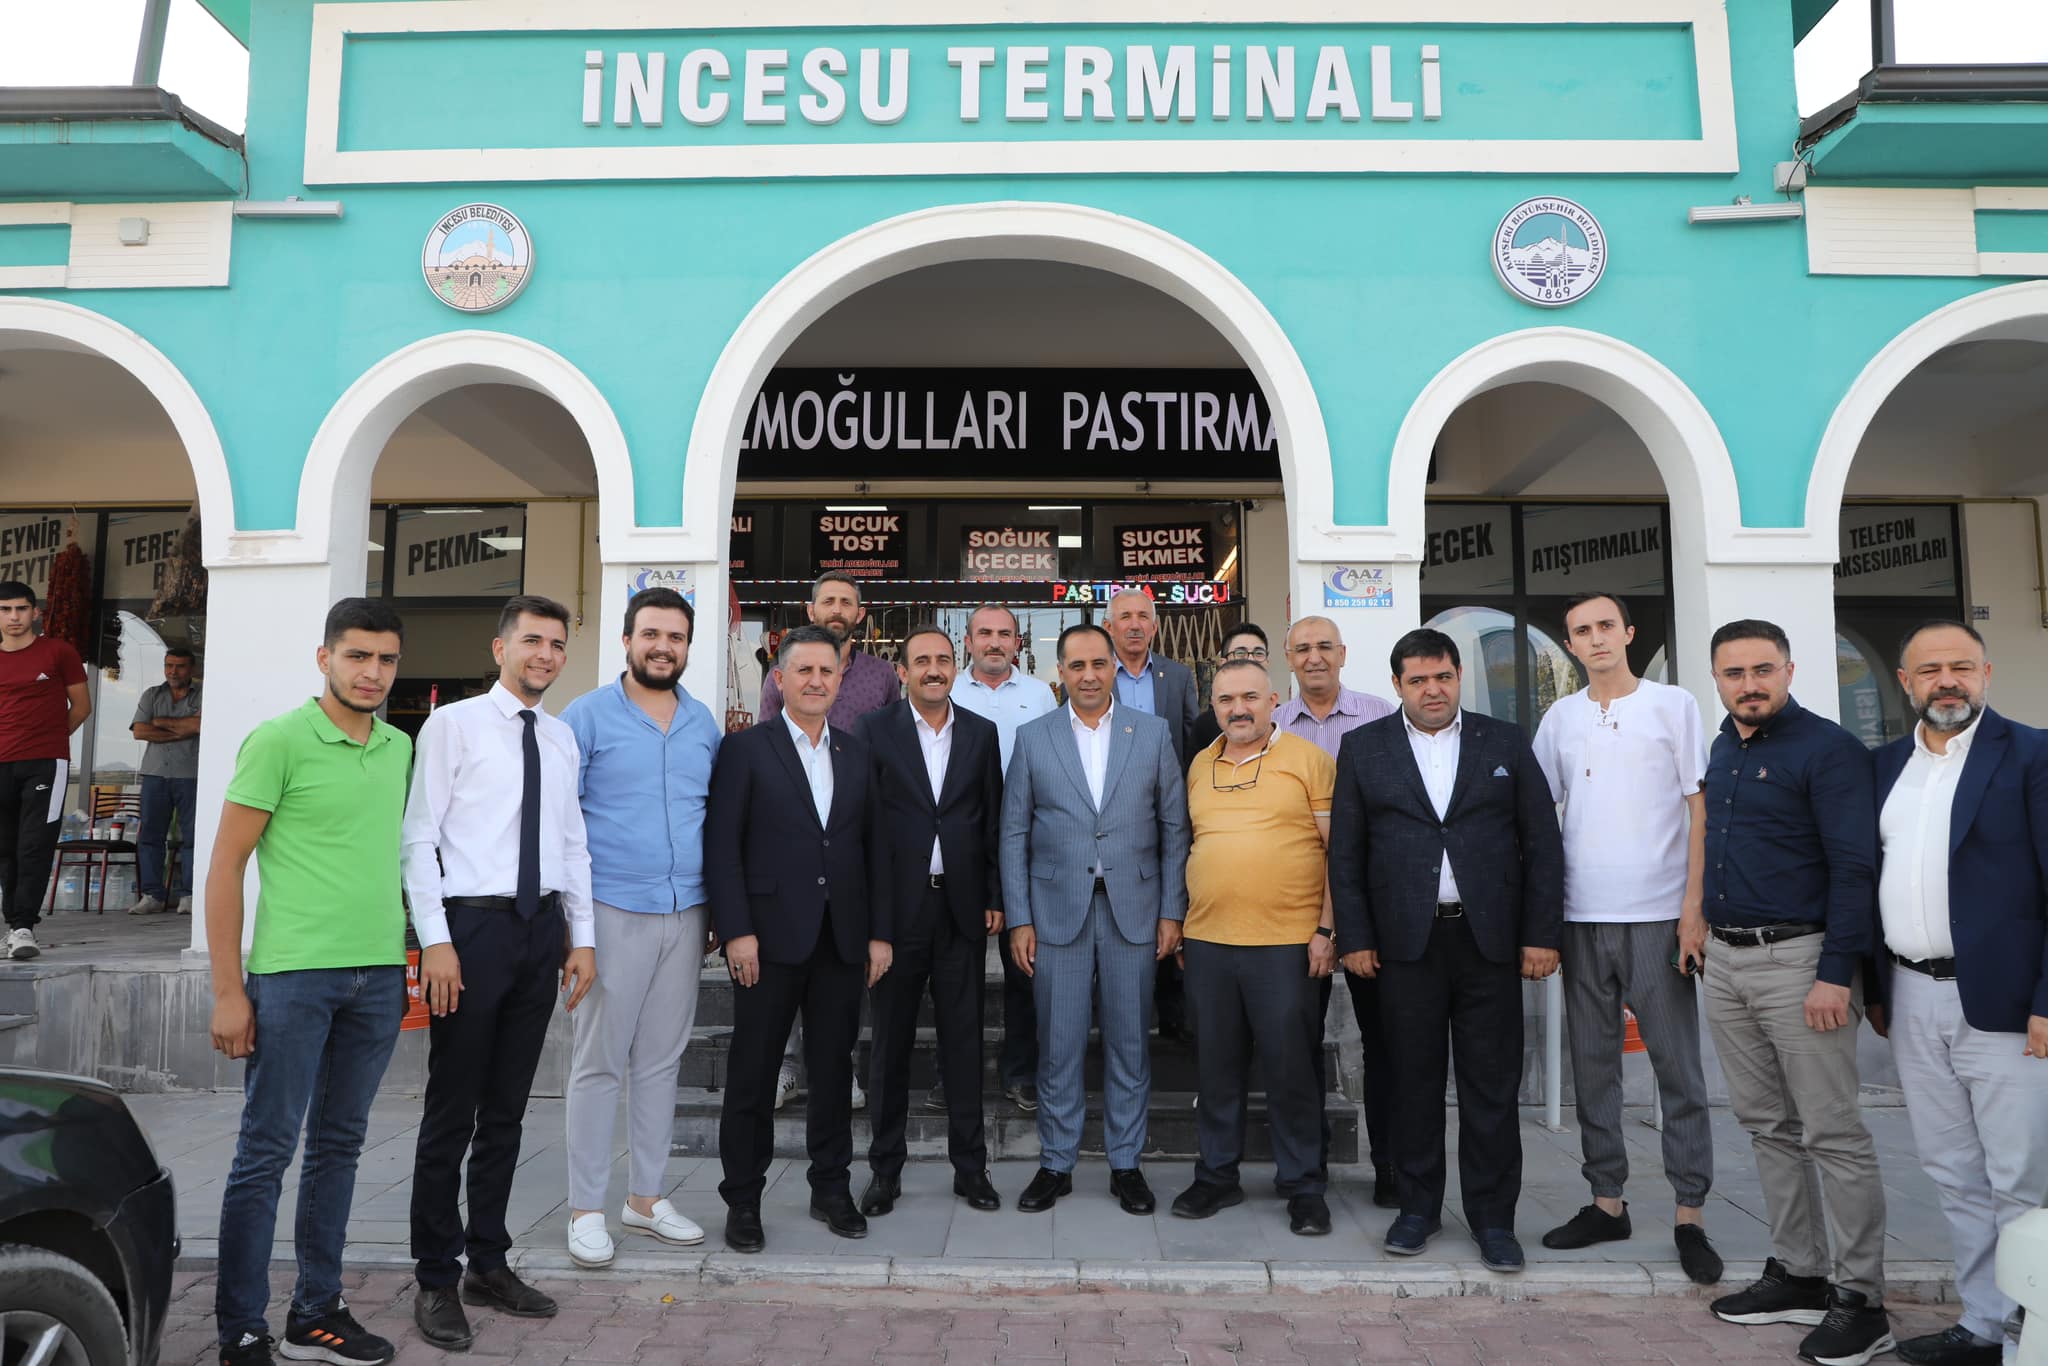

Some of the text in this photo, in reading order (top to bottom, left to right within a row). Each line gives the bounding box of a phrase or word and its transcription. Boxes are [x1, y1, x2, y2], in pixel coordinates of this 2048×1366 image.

[1502, 224, 1514, 271] KAYSERİ
[1511, 202, 1576, 225] BÜYÜKŞEHİR
[1537, 286, 1571, 299] 1869
[740, 373, 1027, 451] MOĞULLARI
[819, 516, 900, 533] SUCUK
[968, 527, 1051, 548] SOĞUK
[1121, 528, 1203, 548] SUCUK
[1849, 517, 1916, 549] TELEFON
[123, 530, 180, 567] TERE
[407, 525, 509, 577] PEKMEZ
[829, 535, 889, 552] TOST
[1122, 547, 1206, 567] EKMEK
[1420, 521, 1496, 580] ECEK
[1531, 525, 1660, 576] ATIŞTIRMALIK
[1833, 537, 1948, 579] AKSESUARLARI
[967, 549, 1053, 573] İÇECEK
